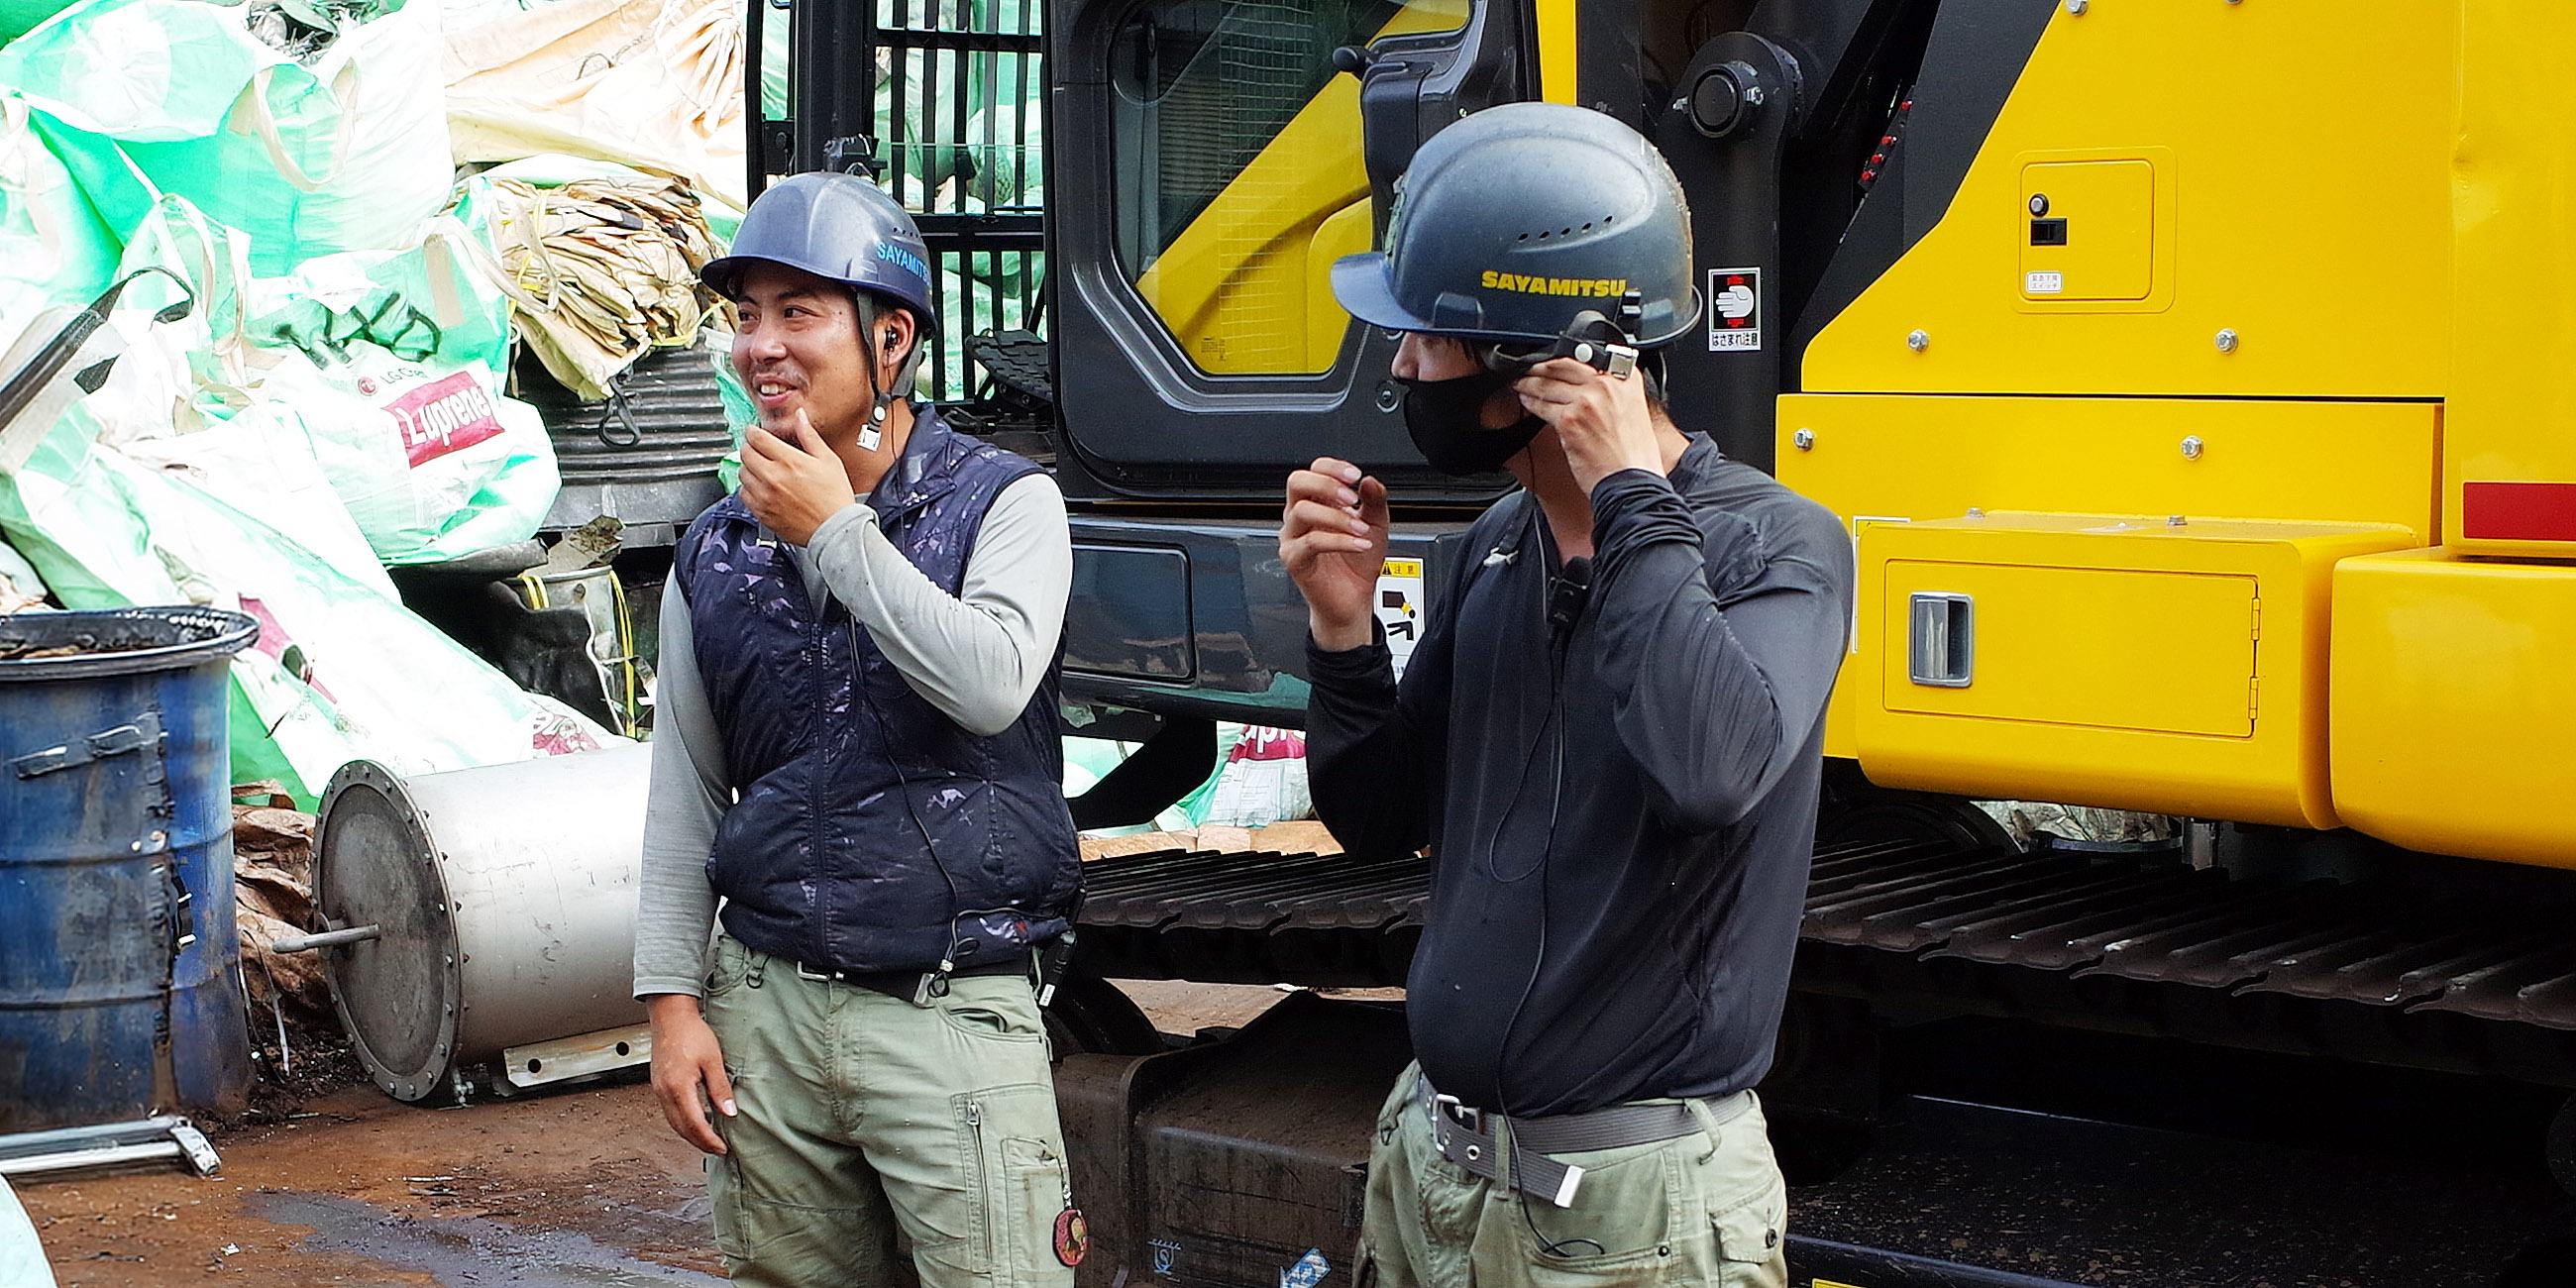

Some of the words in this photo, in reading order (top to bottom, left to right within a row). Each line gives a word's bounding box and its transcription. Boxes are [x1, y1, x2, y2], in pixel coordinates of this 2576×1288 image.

[877, 242, 930, 285] SAYAMITS
[1482, 269, 1626, 297] SAYAMITSU
[393, 385, 492, 447] Luprene
